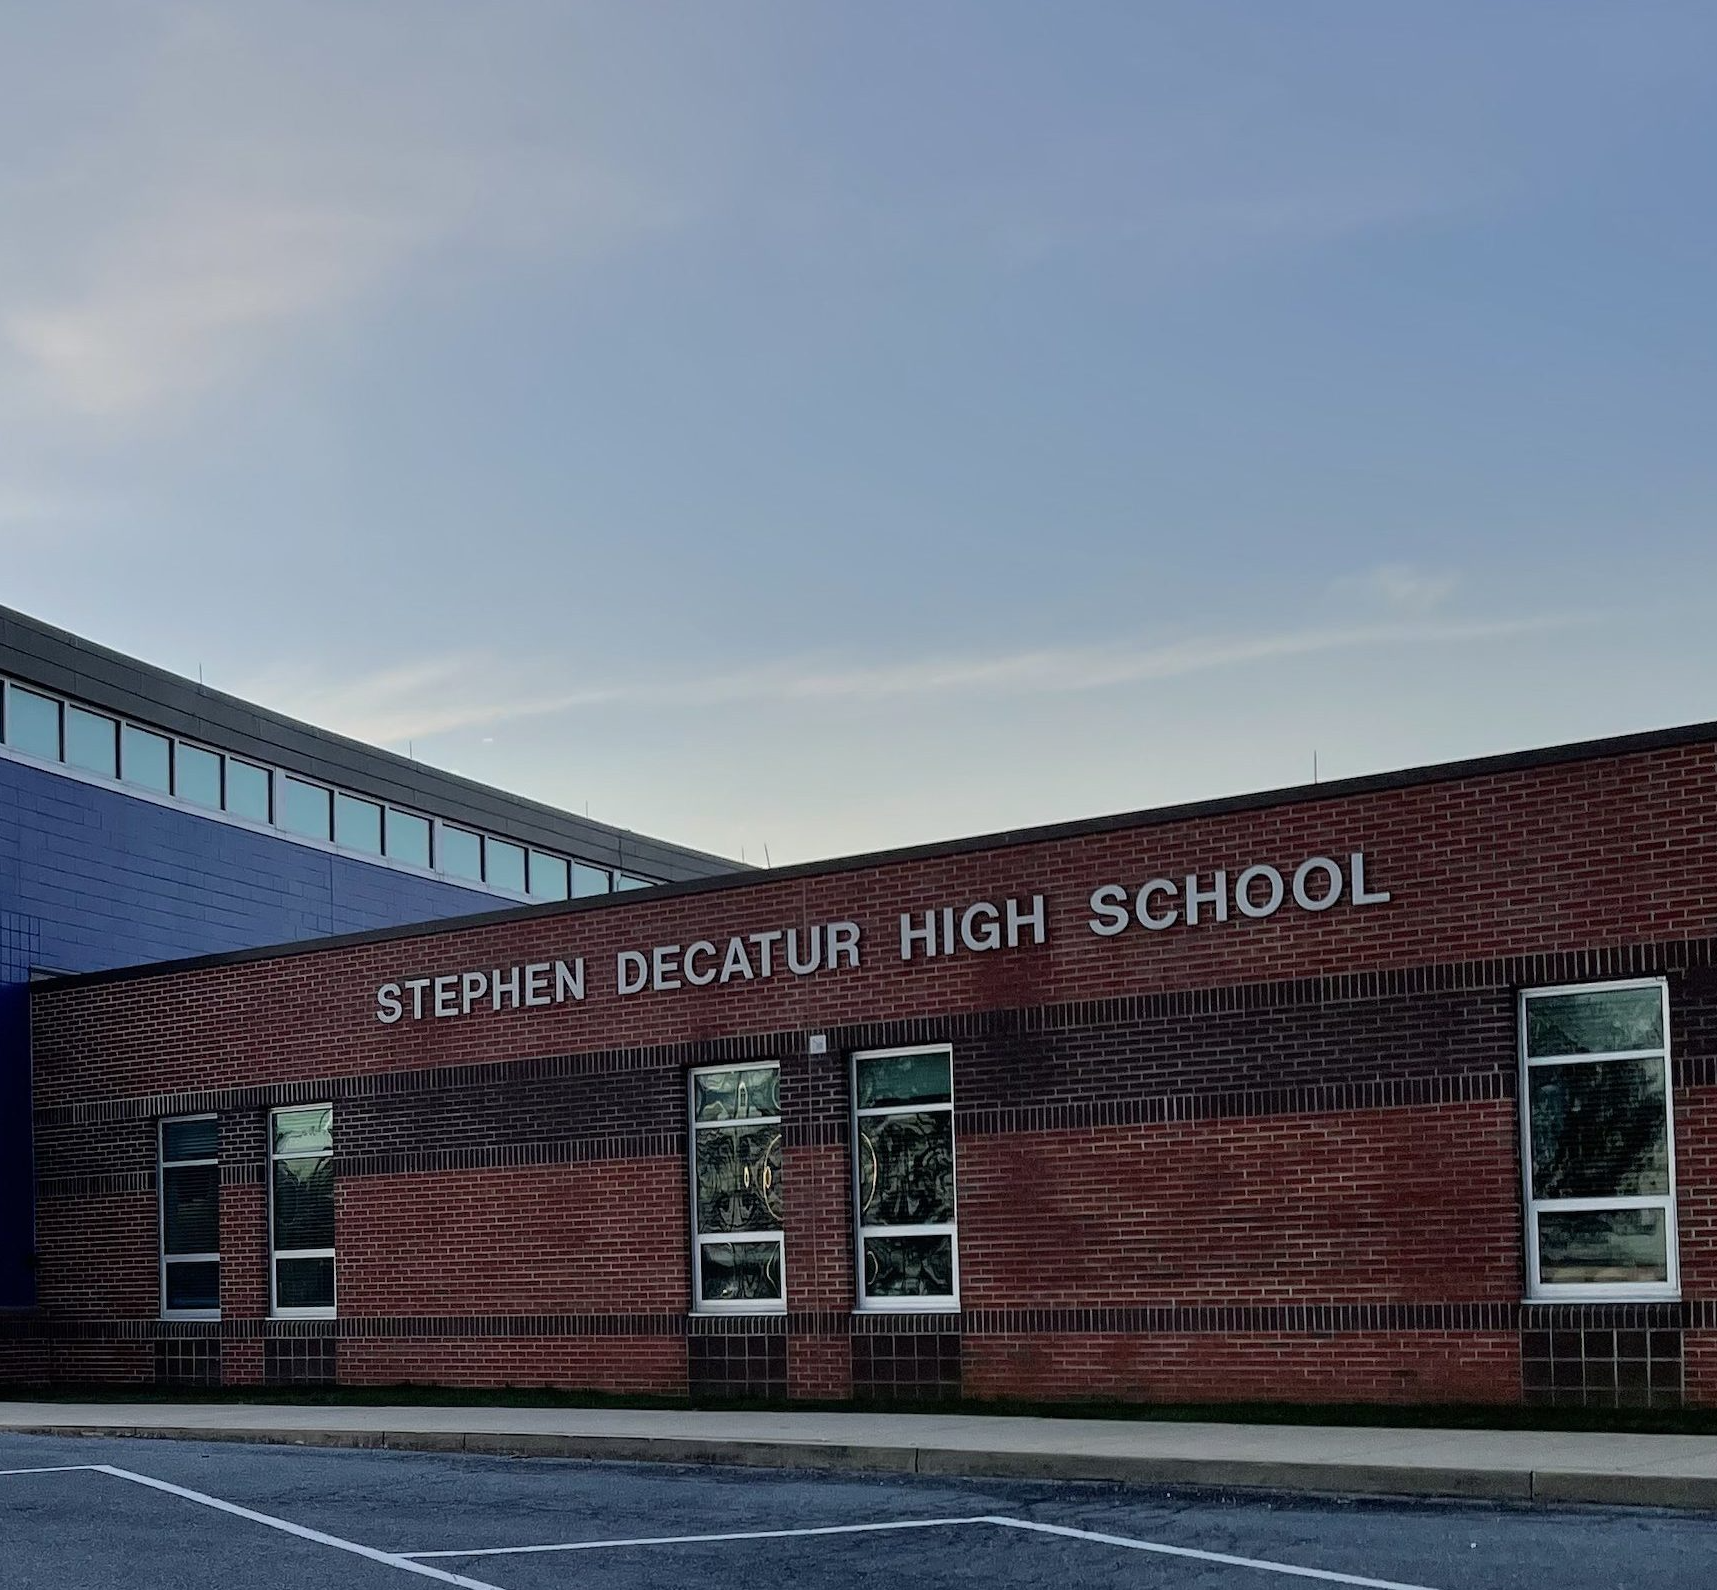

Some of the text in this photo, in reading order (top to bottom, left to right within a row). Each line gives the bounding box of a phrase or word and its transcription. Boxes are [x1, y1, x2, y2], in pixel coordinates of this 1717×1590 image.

[376, 852, 1390, 1024] STEPHEN DECATUR HIGH SCHOOL
